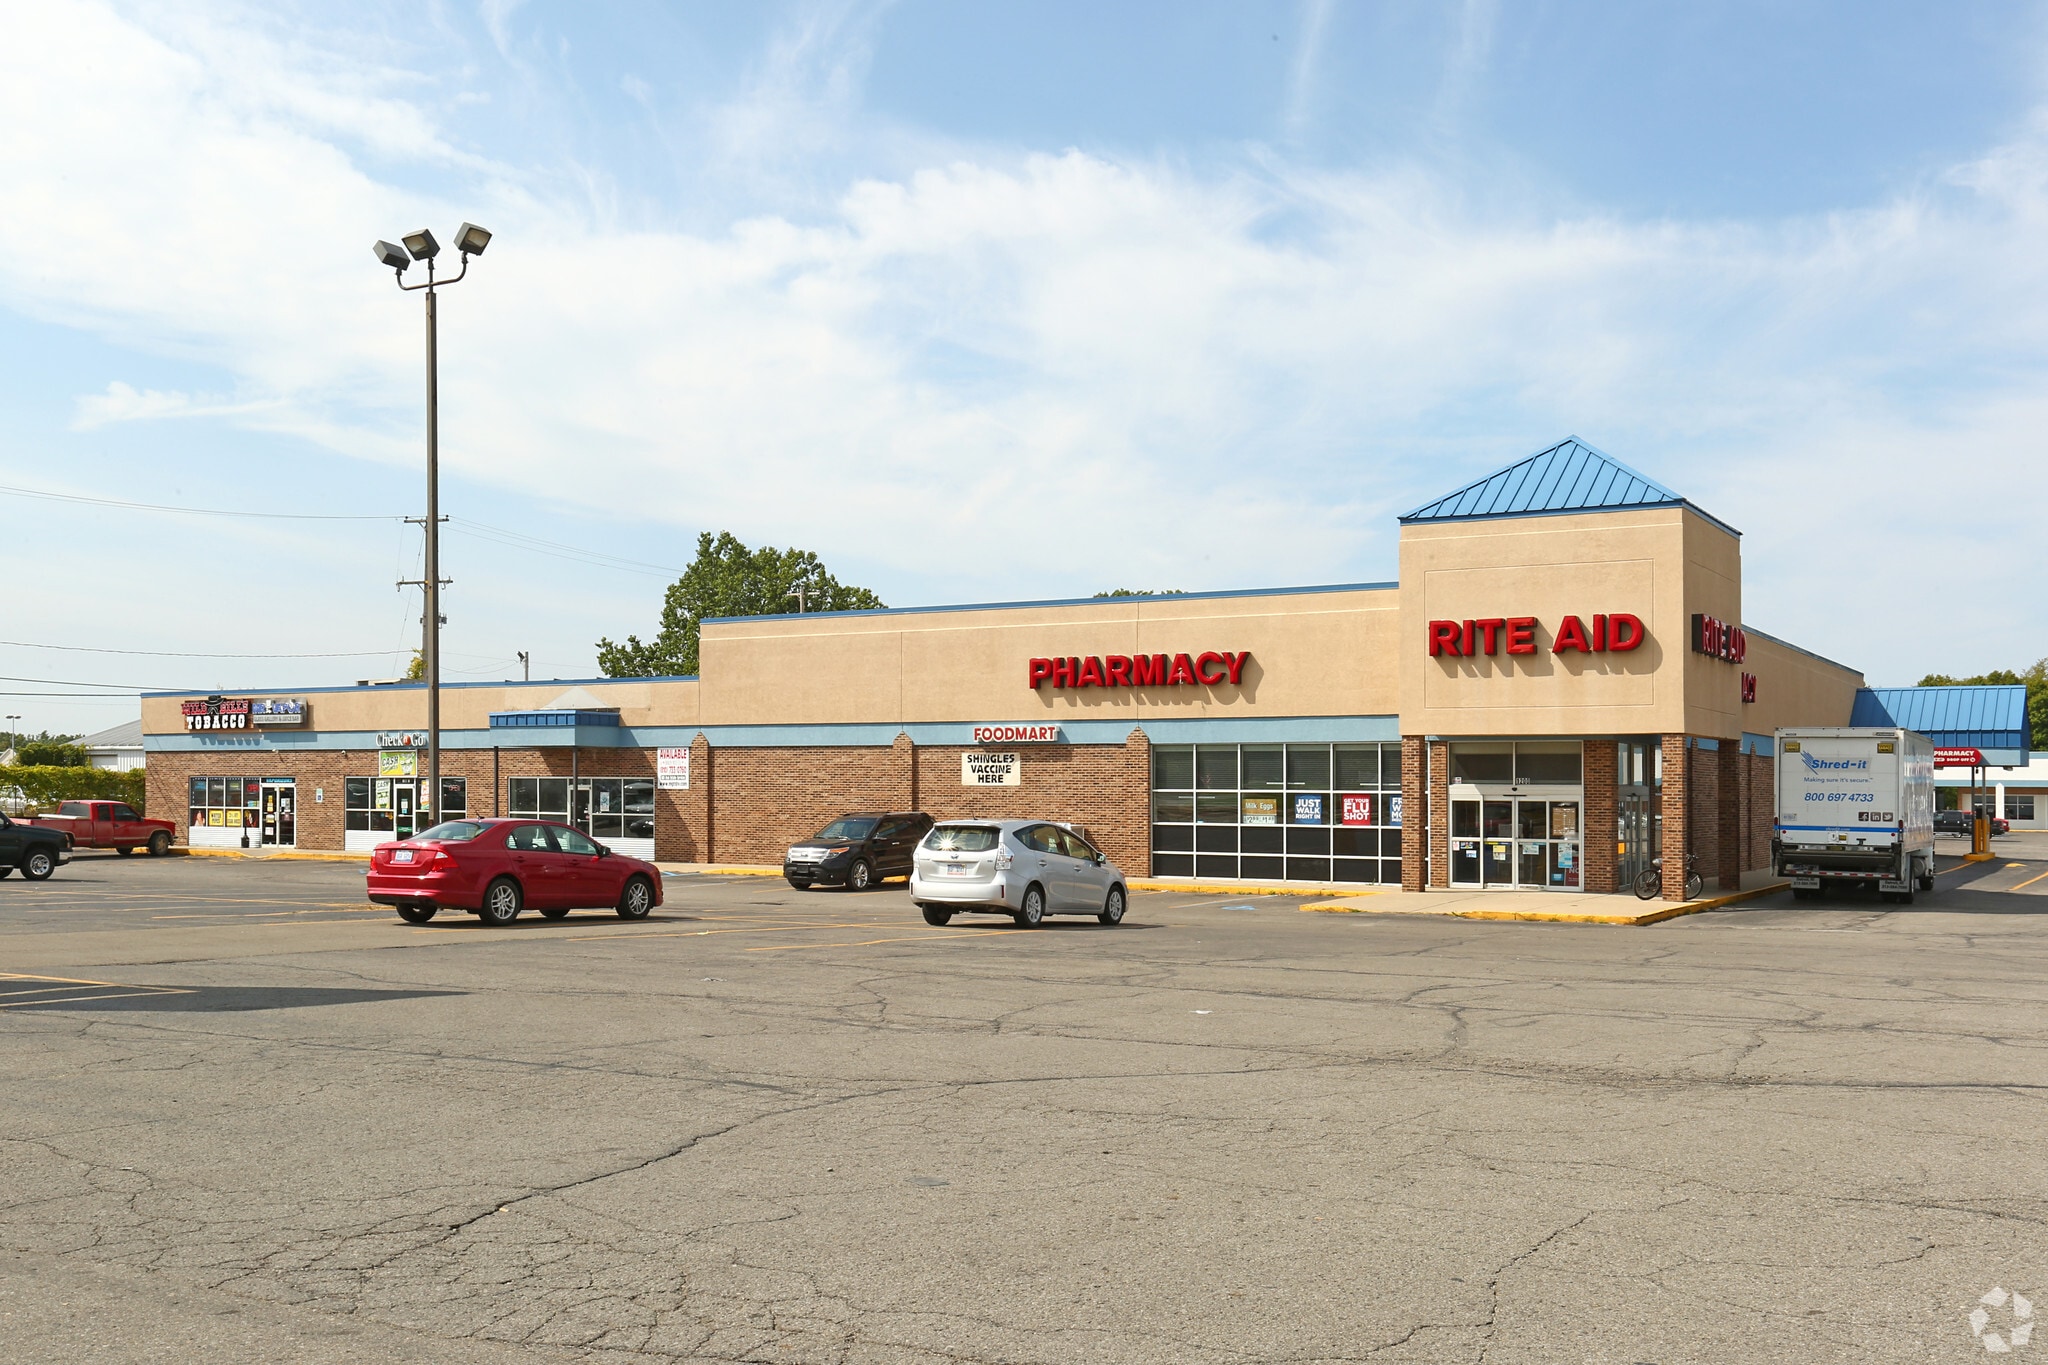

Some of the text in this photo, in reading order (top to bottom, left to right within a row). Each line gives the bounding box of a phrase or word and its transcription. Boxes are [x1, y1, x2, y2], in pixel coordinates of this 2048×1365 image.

[1429, 613, 1645, 656] RITE AID
[1029, 651, 1249, 689] PHARMACY
[181, 702, 207, 715] WILD
[186, 714, 246, 730] TOBACCO
[974, 726, 1056, 741] FOODMART
[375, 731, 404, 747] Check
[411, 732, 424, 747] Go
[660, 749, 687, 759] AVAILABLE
[967, 754, 1016, 763] SHINGLES
[970, 764, 1012, 774] VACCINE
[1811, 760, 1867, 769] Shred-it
[977, 774, 1004, 783] HERE
[1804, 793, 1874, 802] 800 697 4733
[1260, 802, 1274, 811] Eggs
[1295, 799, 1321, 807] JUST
[1343, 803, 1369, 813] FLU
[1343, 812, 1370, 820] SHOT
